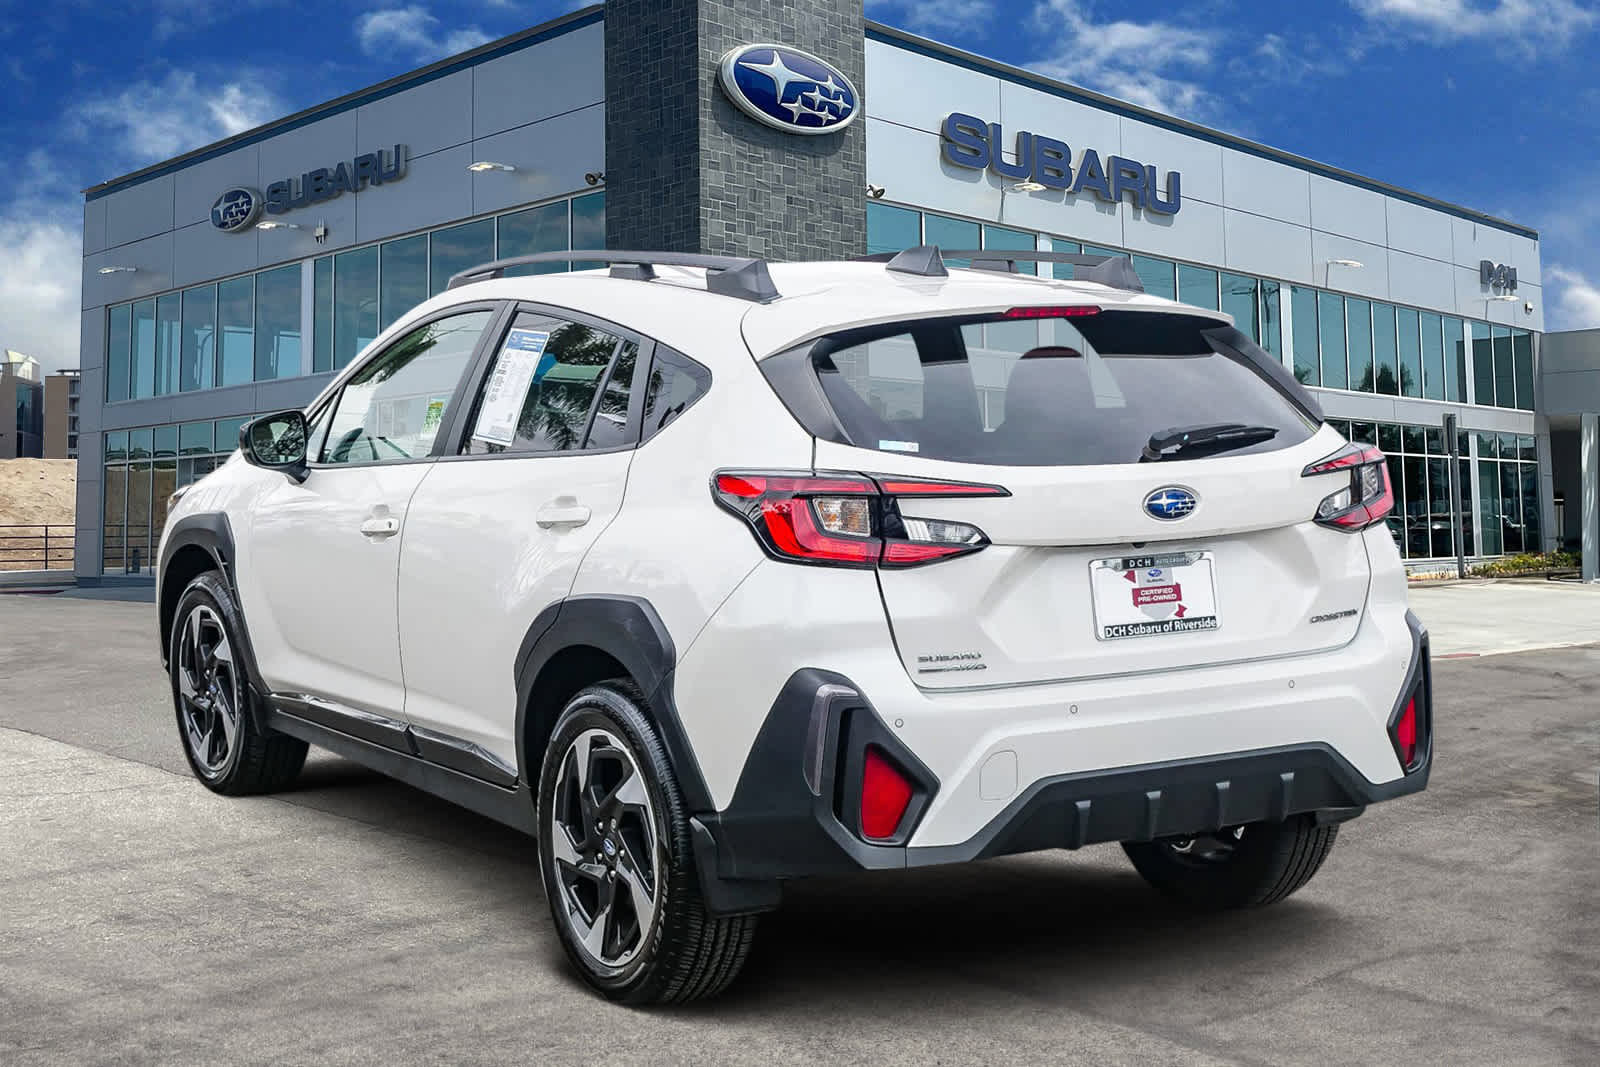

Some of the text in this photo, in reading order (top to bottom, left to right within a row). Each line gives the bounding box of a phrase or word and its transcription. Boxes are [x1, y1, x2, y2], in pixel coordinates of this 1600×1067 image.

[940, 111, 1181, 215] SUBARU
[265, 143, 408, 215] SUBARU
[1128, 558, 1152, 568] DCH
[1140, 587, 1174, 596] CERTIFIED
[1137, 593, 1178, 603] PRE-OWNED
[1105, 617, 1217, 638] DCH Subaru of Riverside
[918, 652, 982, 663] SUBARU
